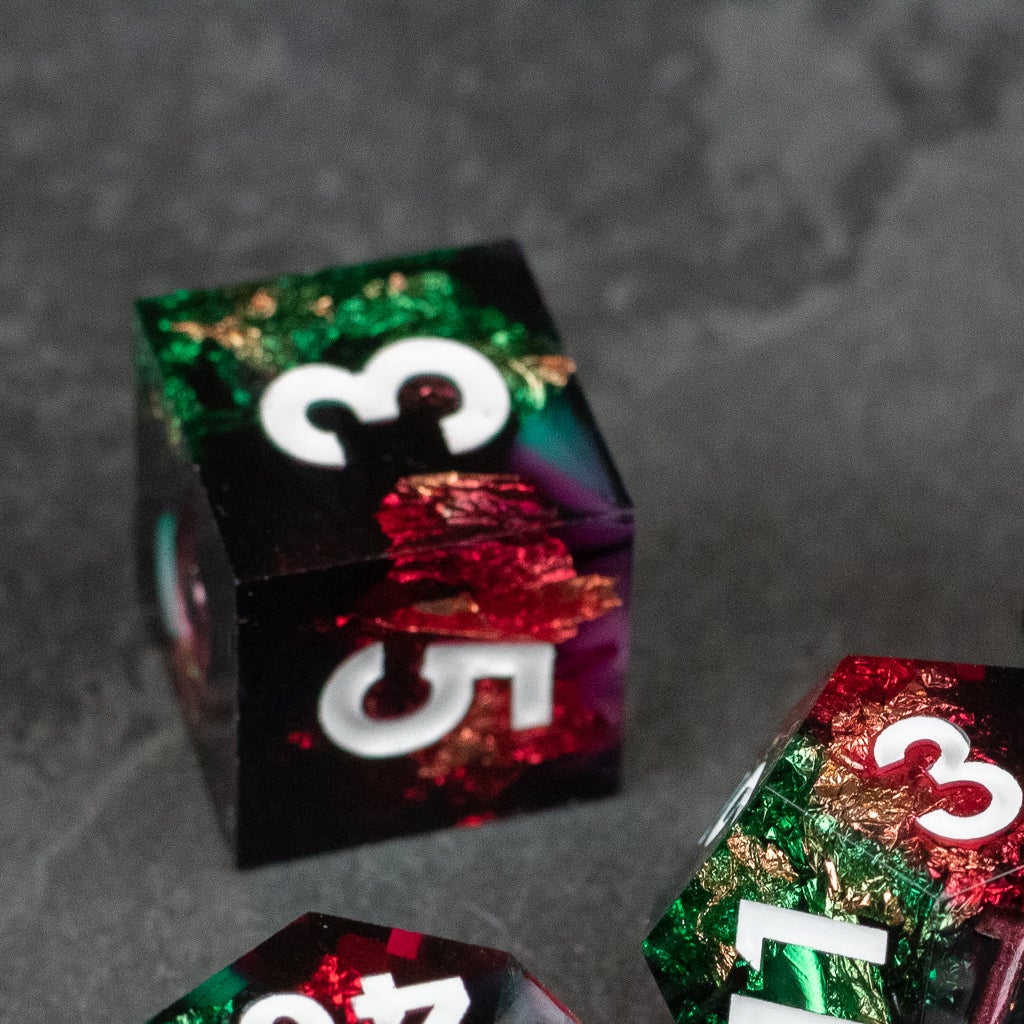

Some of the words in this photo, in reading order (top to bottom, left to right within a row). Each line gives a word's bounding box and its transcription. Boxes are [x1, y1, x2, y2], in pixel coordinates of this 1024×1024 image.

[259, 336, 511, 468] 3
[317, 640, 557, 759] 5
[873, 715, 1024, 842] 3
